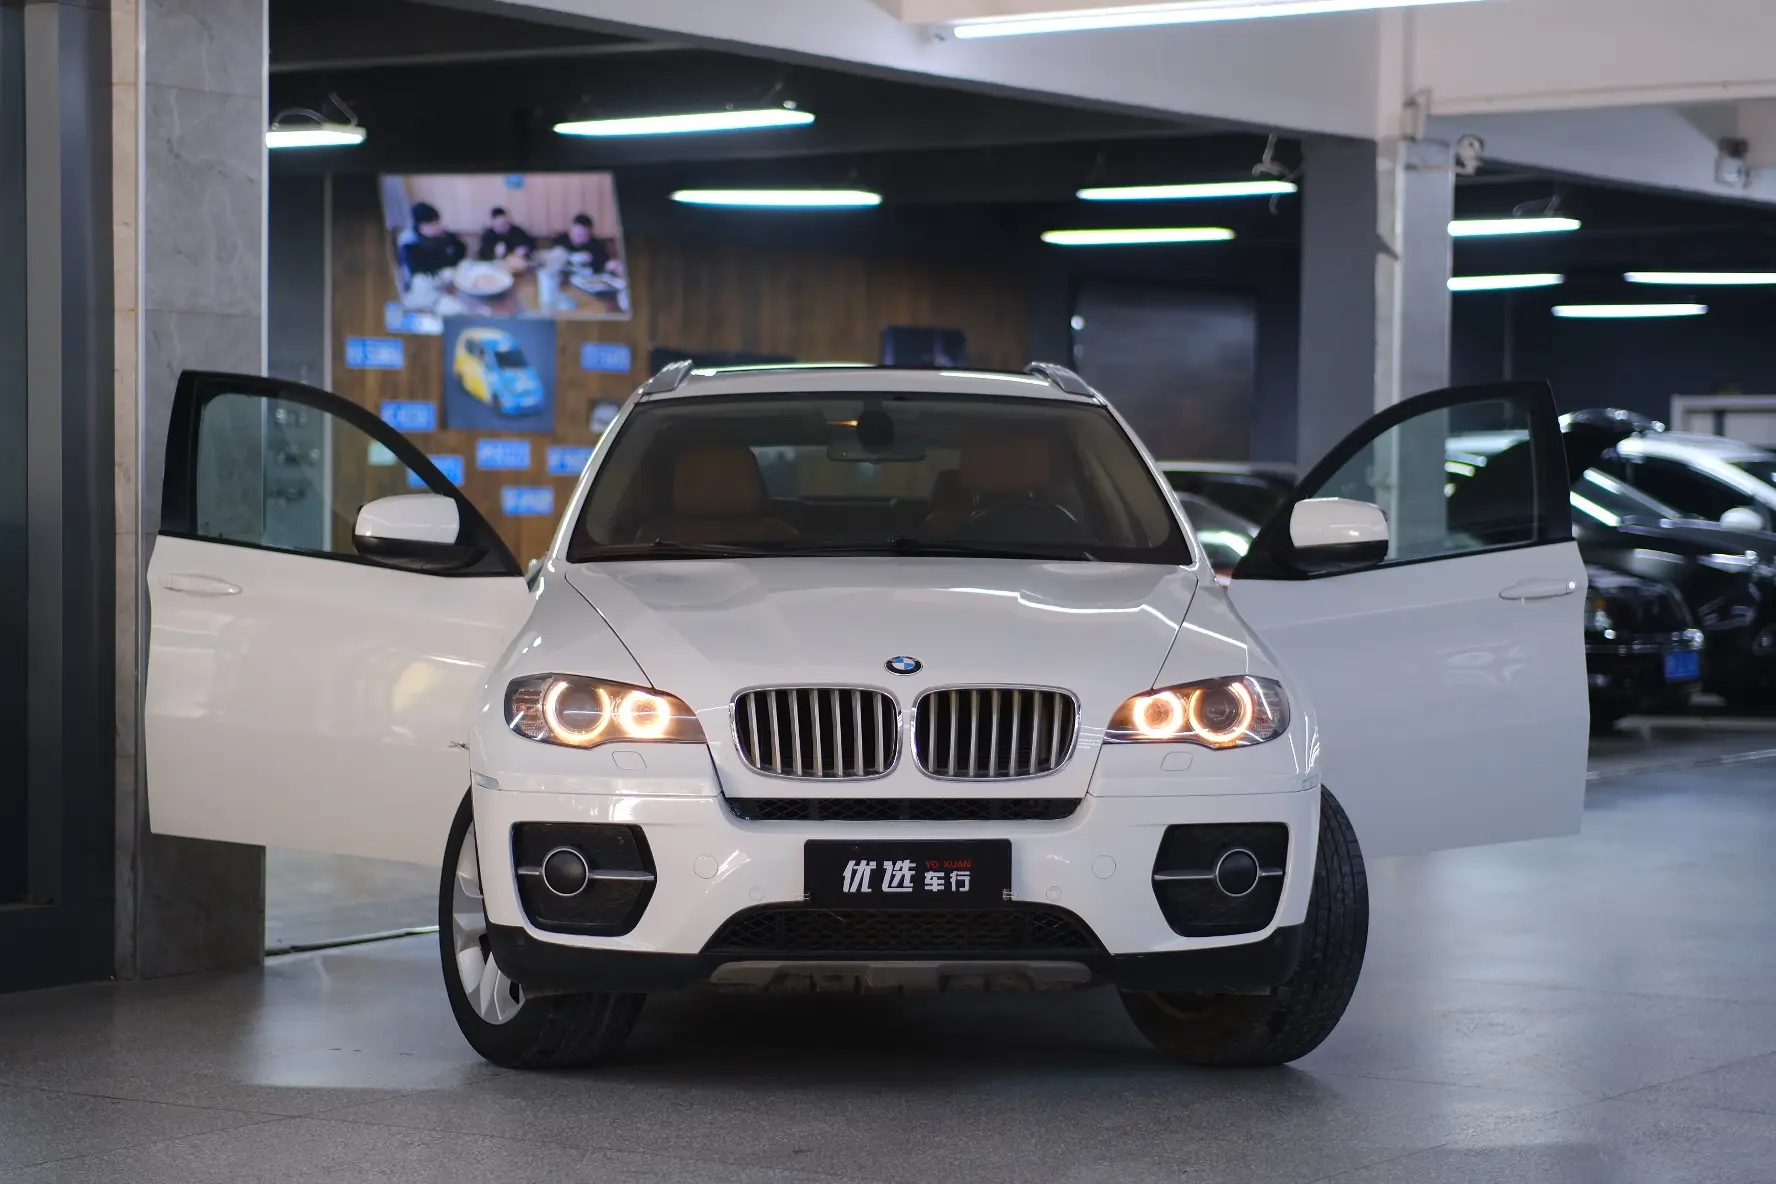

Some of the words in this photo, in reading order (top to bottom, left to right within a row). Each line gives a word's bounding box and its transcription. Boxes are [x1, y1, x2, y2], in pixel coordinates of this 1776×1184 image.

[925, 860, 939, 869] YO
[943, 860, 971, 869] XUAN
[842, 859, 916, 893] 优选
[924, 870, 971, 892] 车行
